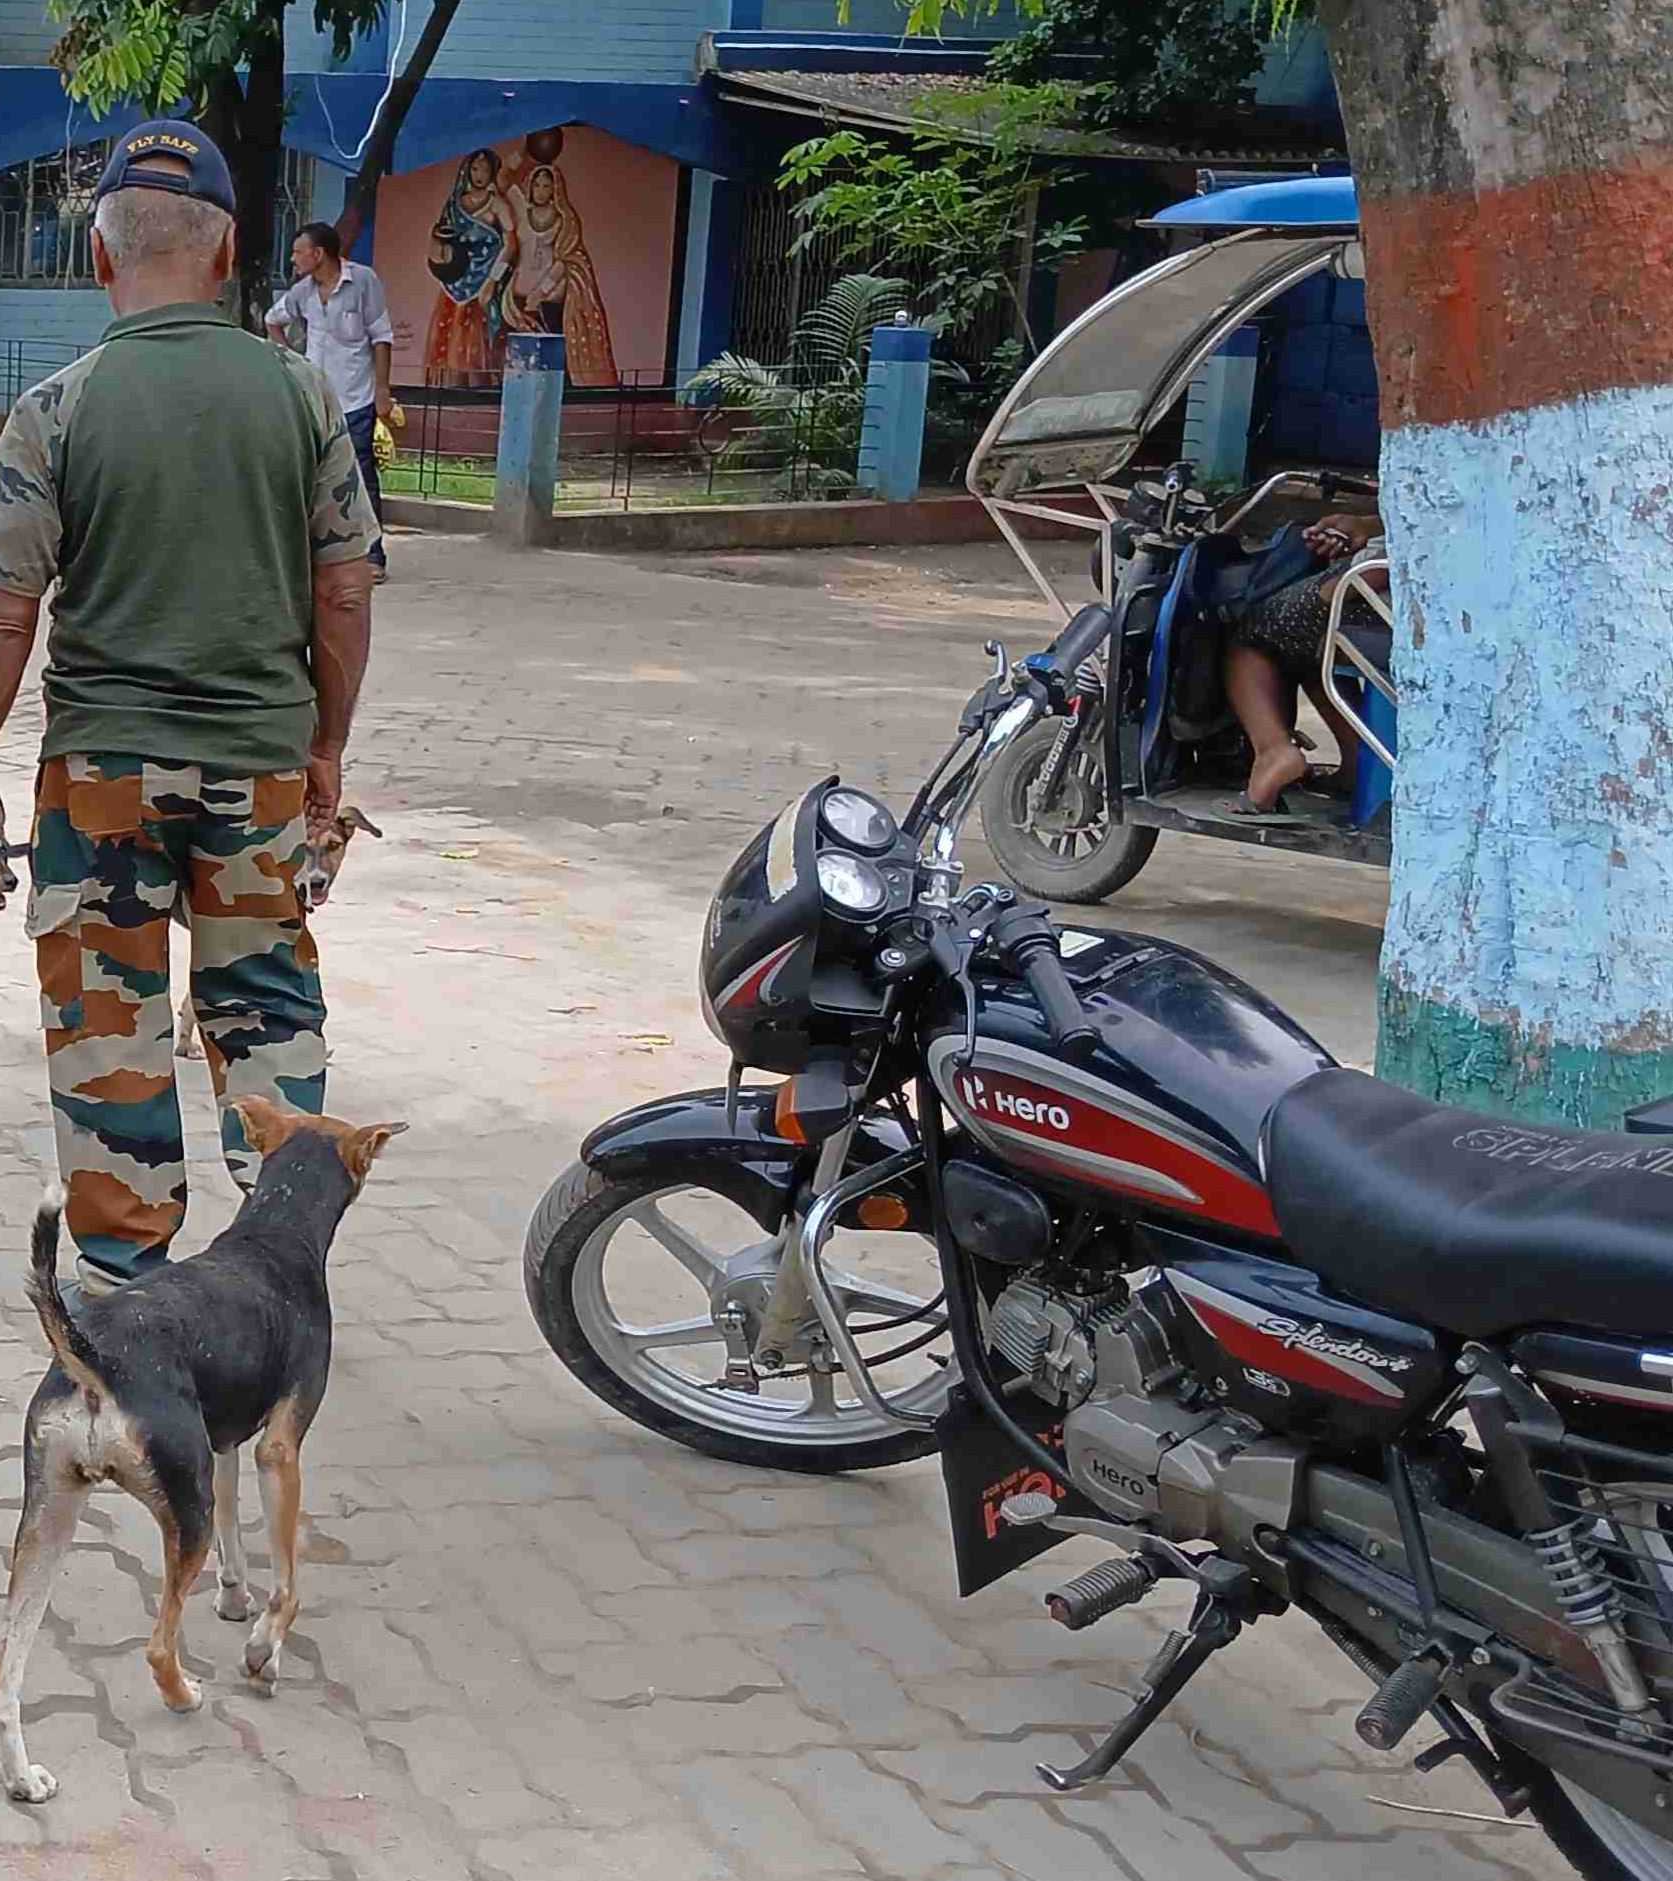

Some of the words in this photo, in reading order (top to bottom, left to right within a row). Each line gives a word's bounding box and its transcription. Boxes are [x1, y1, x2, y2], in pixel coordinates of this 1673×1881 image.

[127, 135, 155, 152] FLY
[160, 135, 200, 152] SAFE
[994, 1091, 1070, 1131] Hero
[1092, 1459, 1145, 1496] Hero
